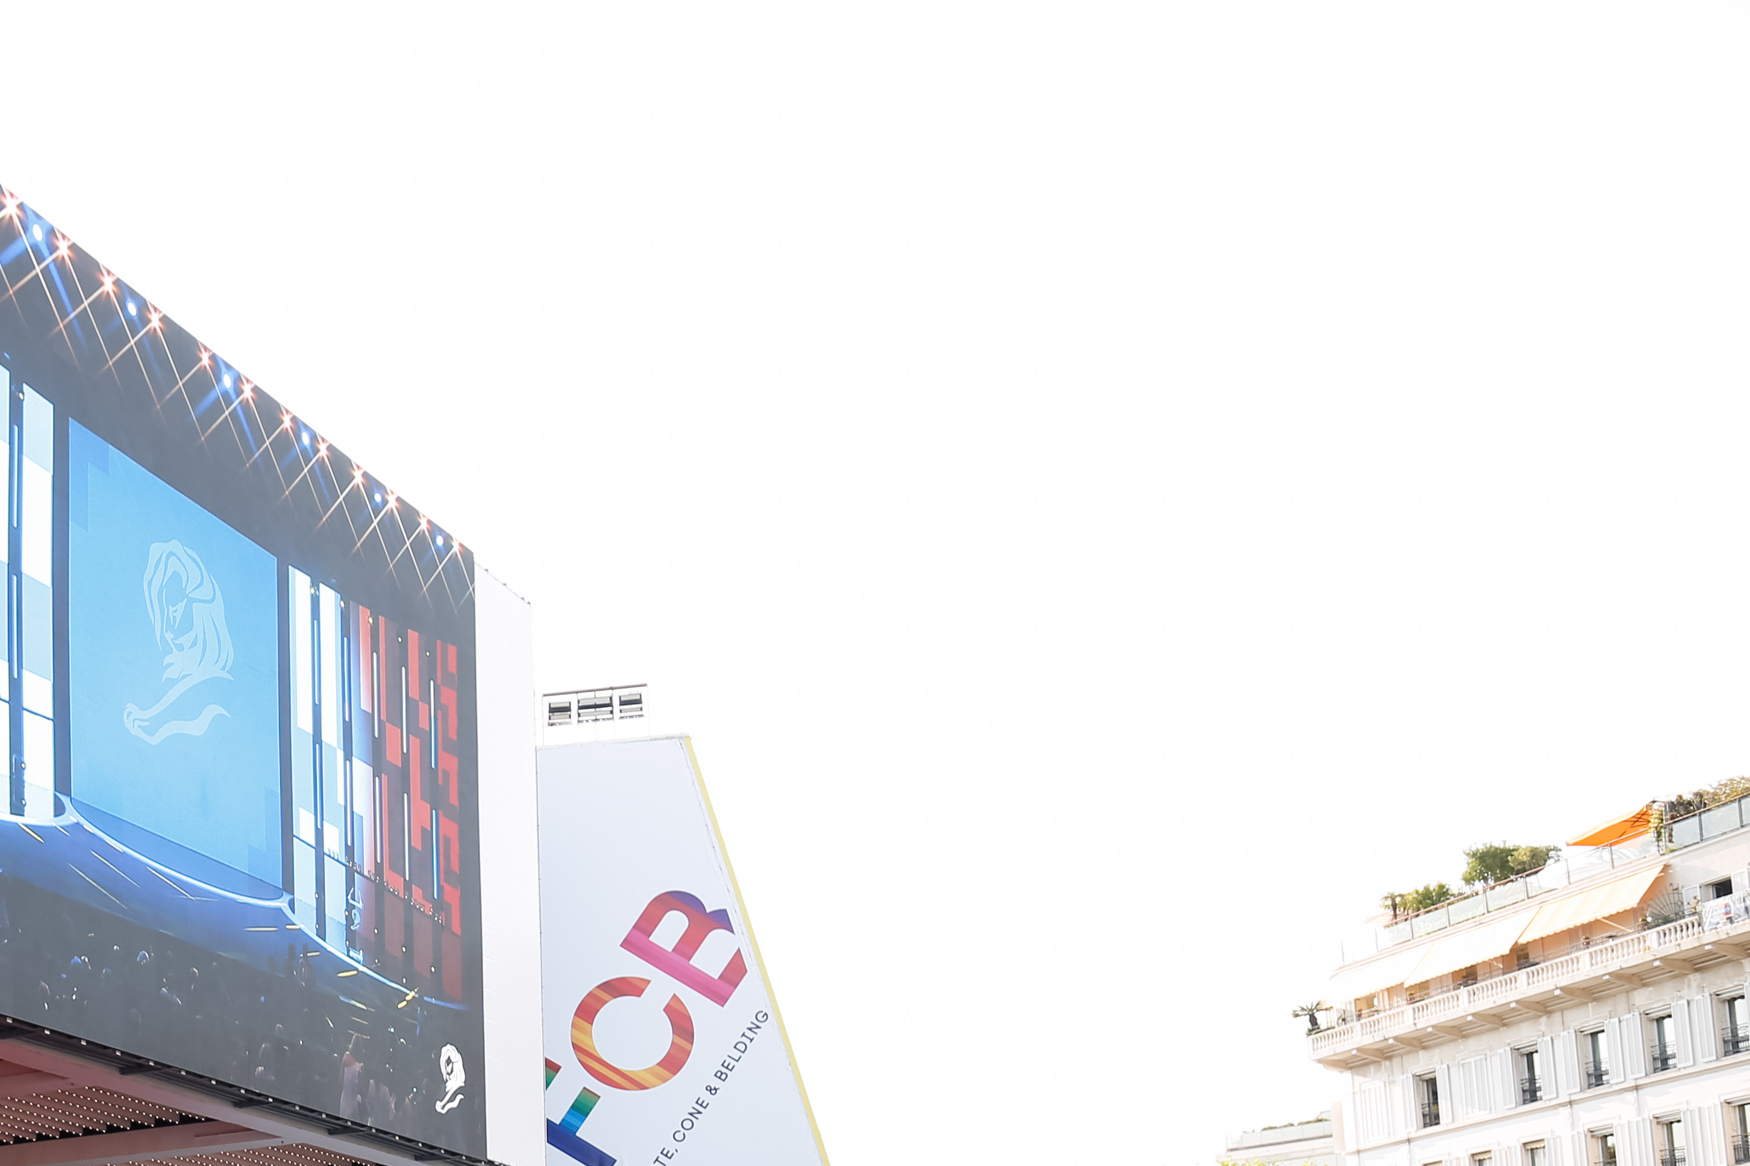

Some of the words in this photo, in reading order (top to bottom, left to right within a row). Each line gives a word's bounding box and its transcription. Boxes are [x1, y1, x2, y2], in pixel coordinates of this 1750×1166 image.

[673, 1096, 710, 1143] CONE
[705, 1084, 720, 1096] &
[714, 1009, 770, 1083] BELDING
